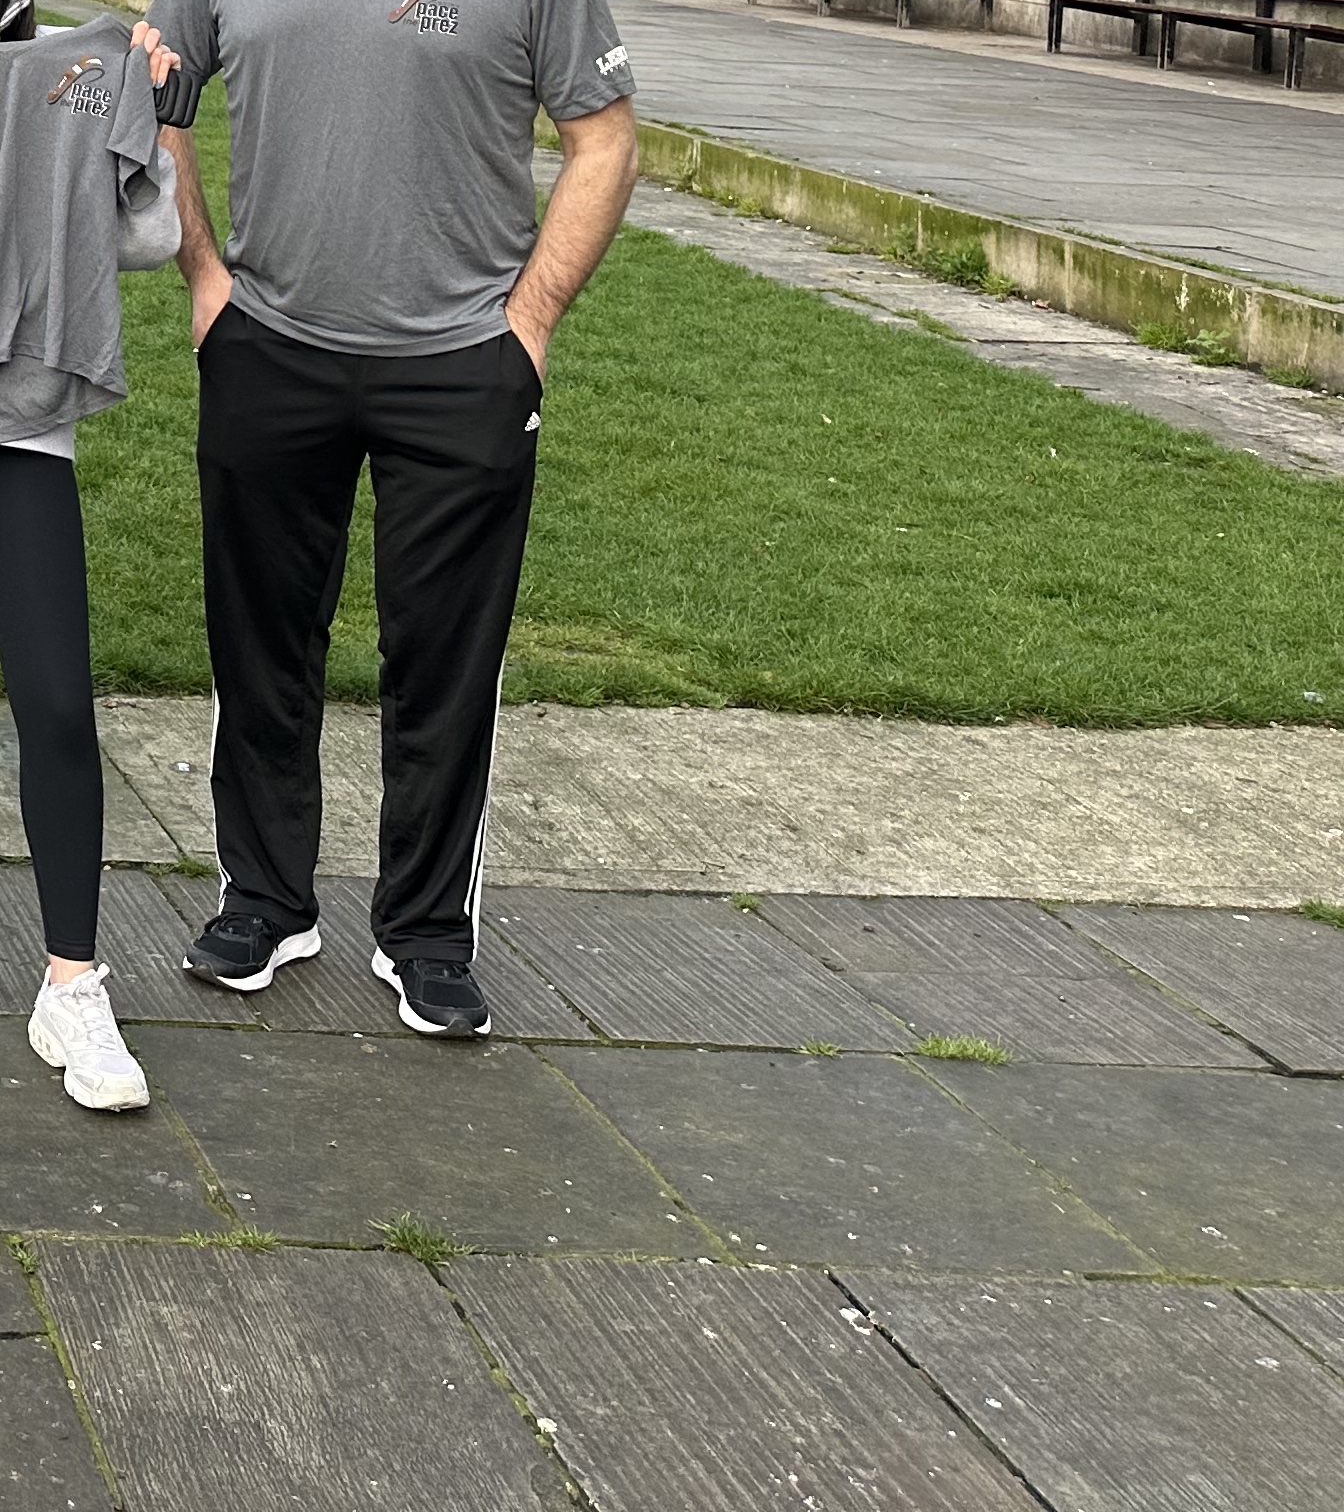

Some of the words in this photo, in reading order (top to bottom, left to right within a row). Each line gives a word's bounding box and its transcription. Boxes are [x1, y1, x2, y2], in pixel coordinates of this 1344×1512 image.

[415, 2, 459, 21] pace
[419, 17, 459, 36] prez
[69, 83, 112, 103] pace
[72, 96, 112, 119] prez
